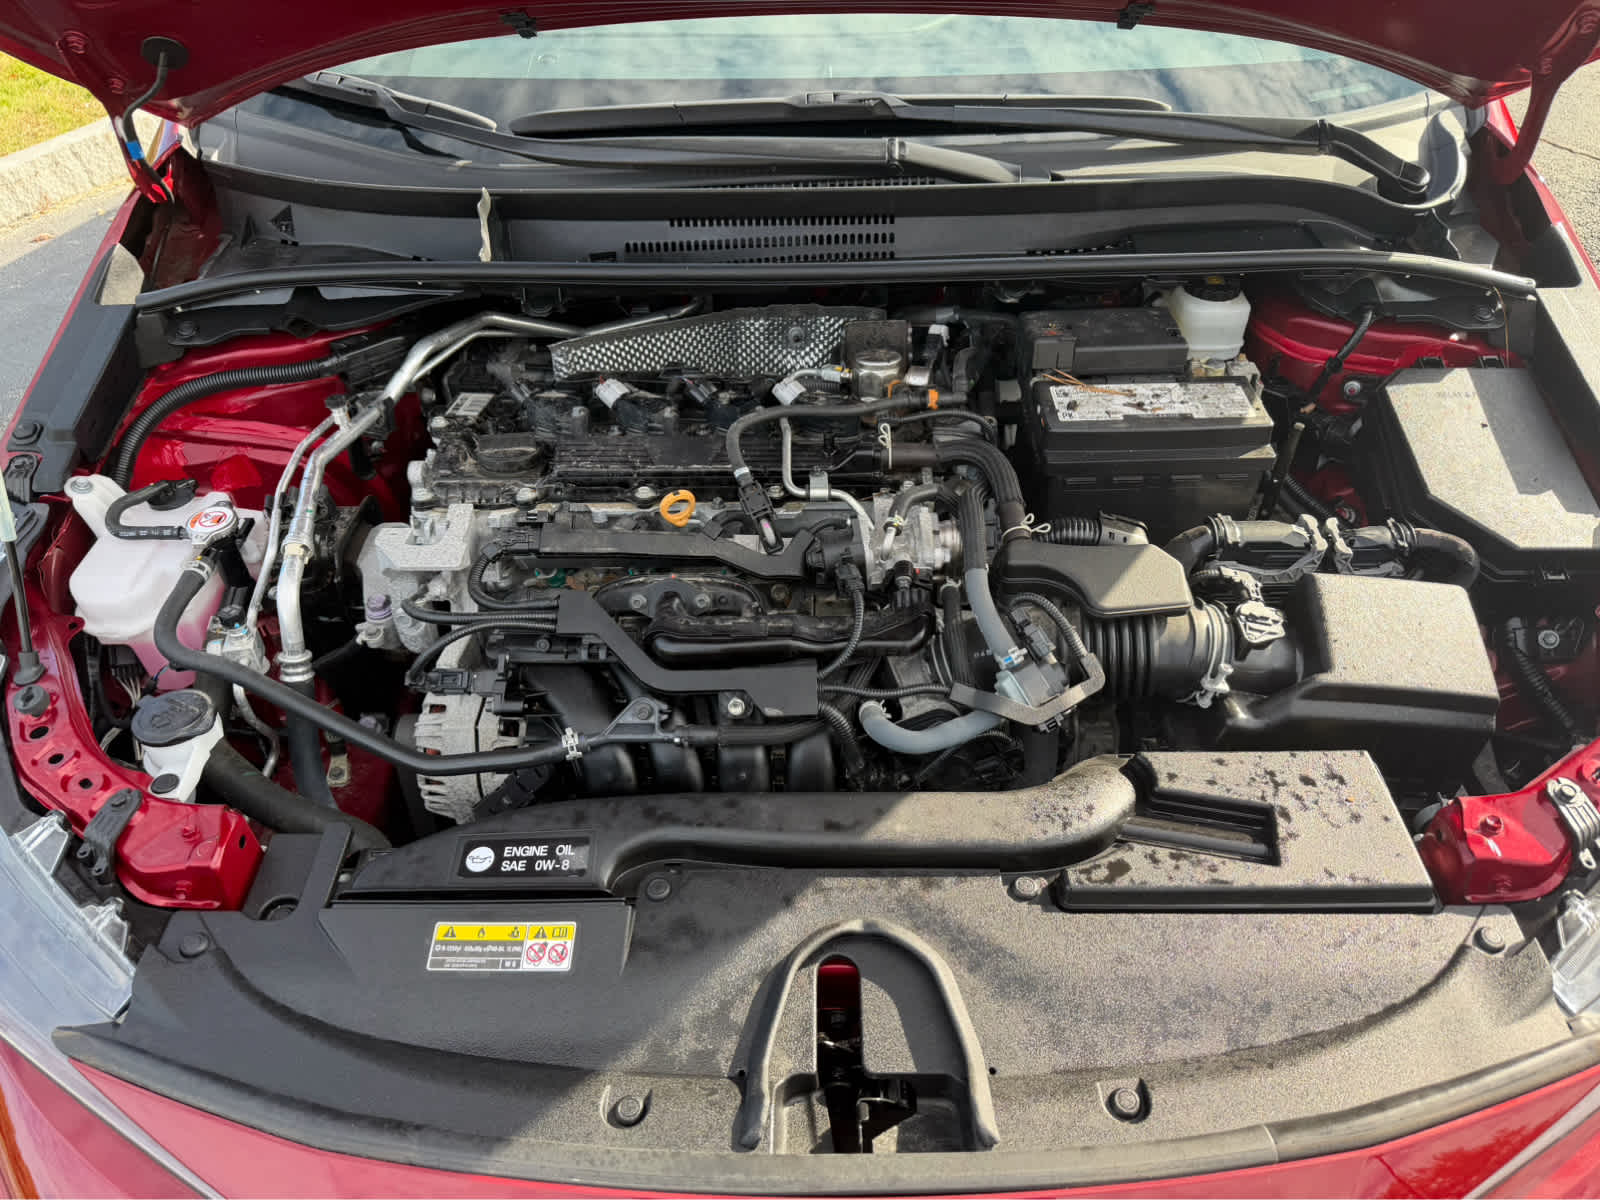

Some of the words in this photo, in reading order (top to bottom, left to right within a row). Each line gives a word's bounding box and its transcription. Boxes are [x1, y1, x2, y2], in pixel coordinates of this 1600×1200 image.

[504, 845, 549, 857] ENGINE
[555, 844, 576, 856] OIL
[501, 860, 527, 871] SAE
[534, 859, 570, 871] 0W-8
